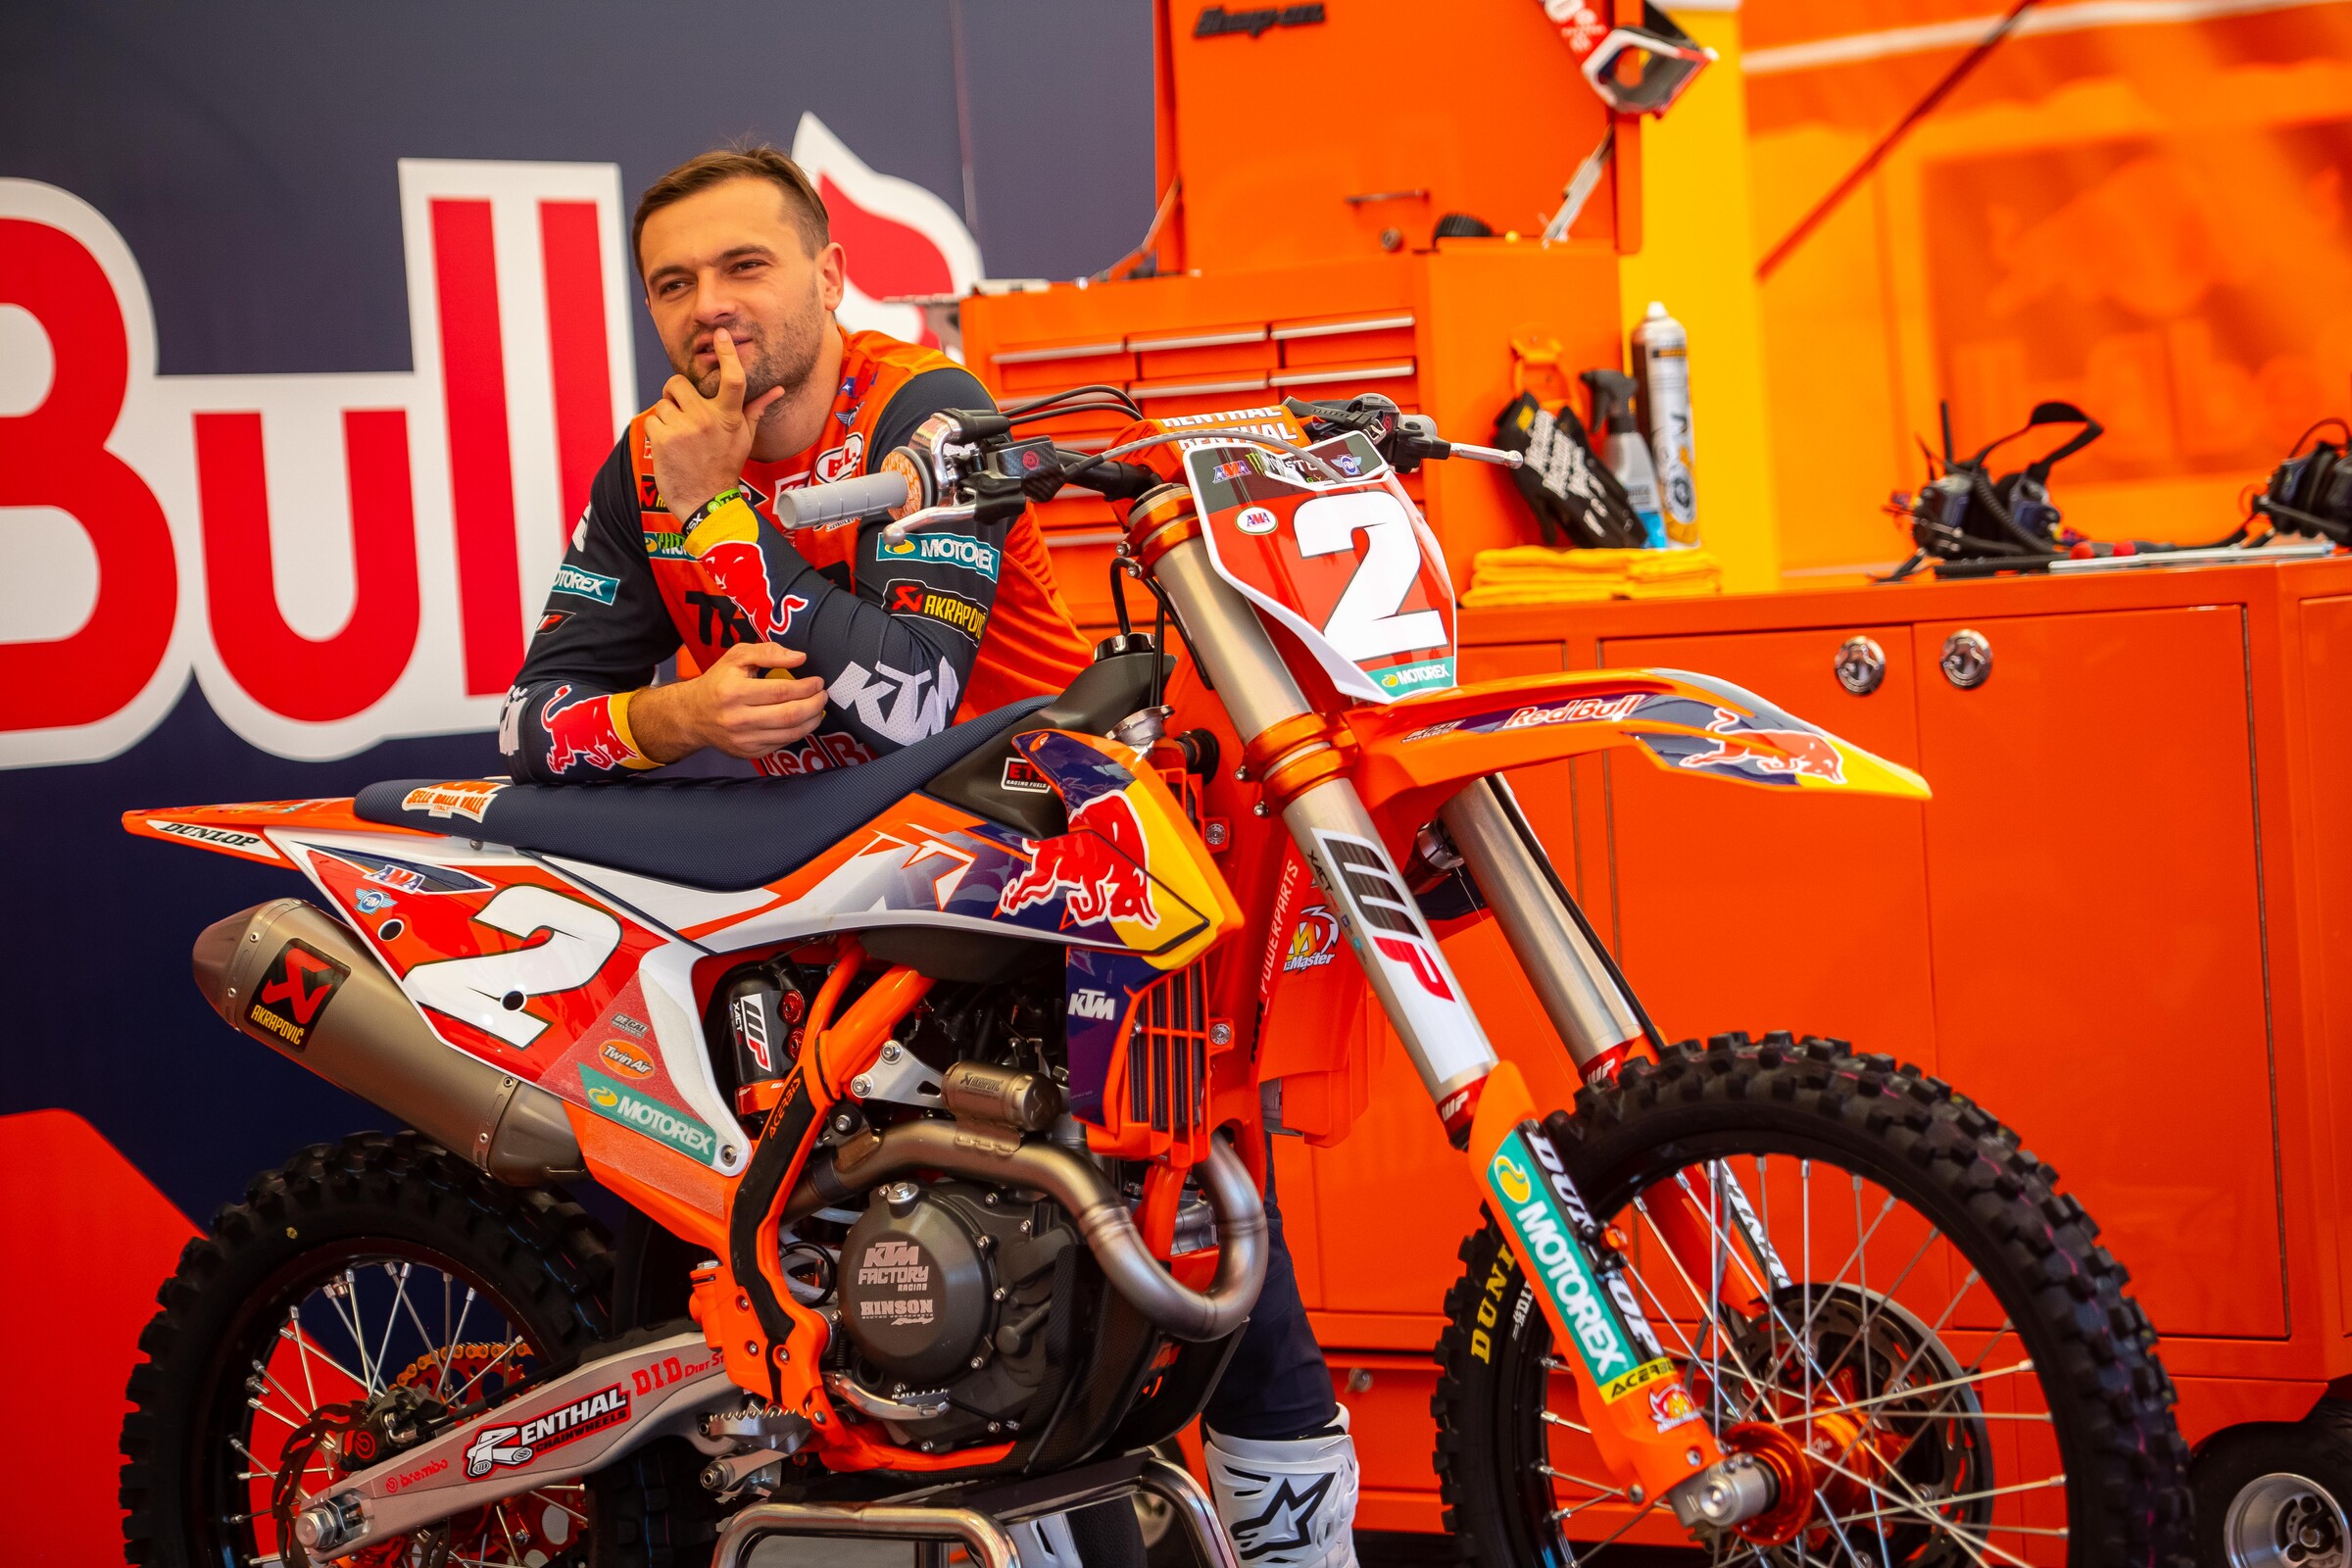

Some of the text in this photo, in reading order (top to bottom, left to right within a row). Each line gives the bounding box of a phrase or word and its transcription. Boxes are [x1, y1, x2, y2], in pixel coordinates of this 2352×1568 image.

[0, 199, 616, 733] Bull
[1213, 460, 1251, 484] AMA
[1247, 513, 1271, 527] AMA
[554, 569, 606, 597] OTOREX
[1293, 491, 1448, 662] 2
[1396, 663, 1450, 685] MOTOREX
[159, 823, 261, 847] DUNLOP
[1307, 850, 1333, 892] XACT
[402, 883, 622, 1050] 2
[733, 1002, 744, 1032] XACT
[1067, 988, 1115, 1021] KTM
[251, 1004, 305, 1045] AKRAPOVIČ
[604, 1045, 653, 1074] Twin Air
[617, 1095, 713, 1155] MOTOREX
[863, 1242, 919, 1267] KTM
[858, 1266, 929, 1285] FACTORY
[1516, 1200, 1628, 1377] MOTOREX
[860, 1299, 933, 1315] HINSON
[631, 1355, 683, 1396] D.I.D
[467, 1388, 627, 1478] RENTHAL
[535, 1408, 628, 1453] CHAINWHEELS
[400, 1459, 449, 1488] brembo
